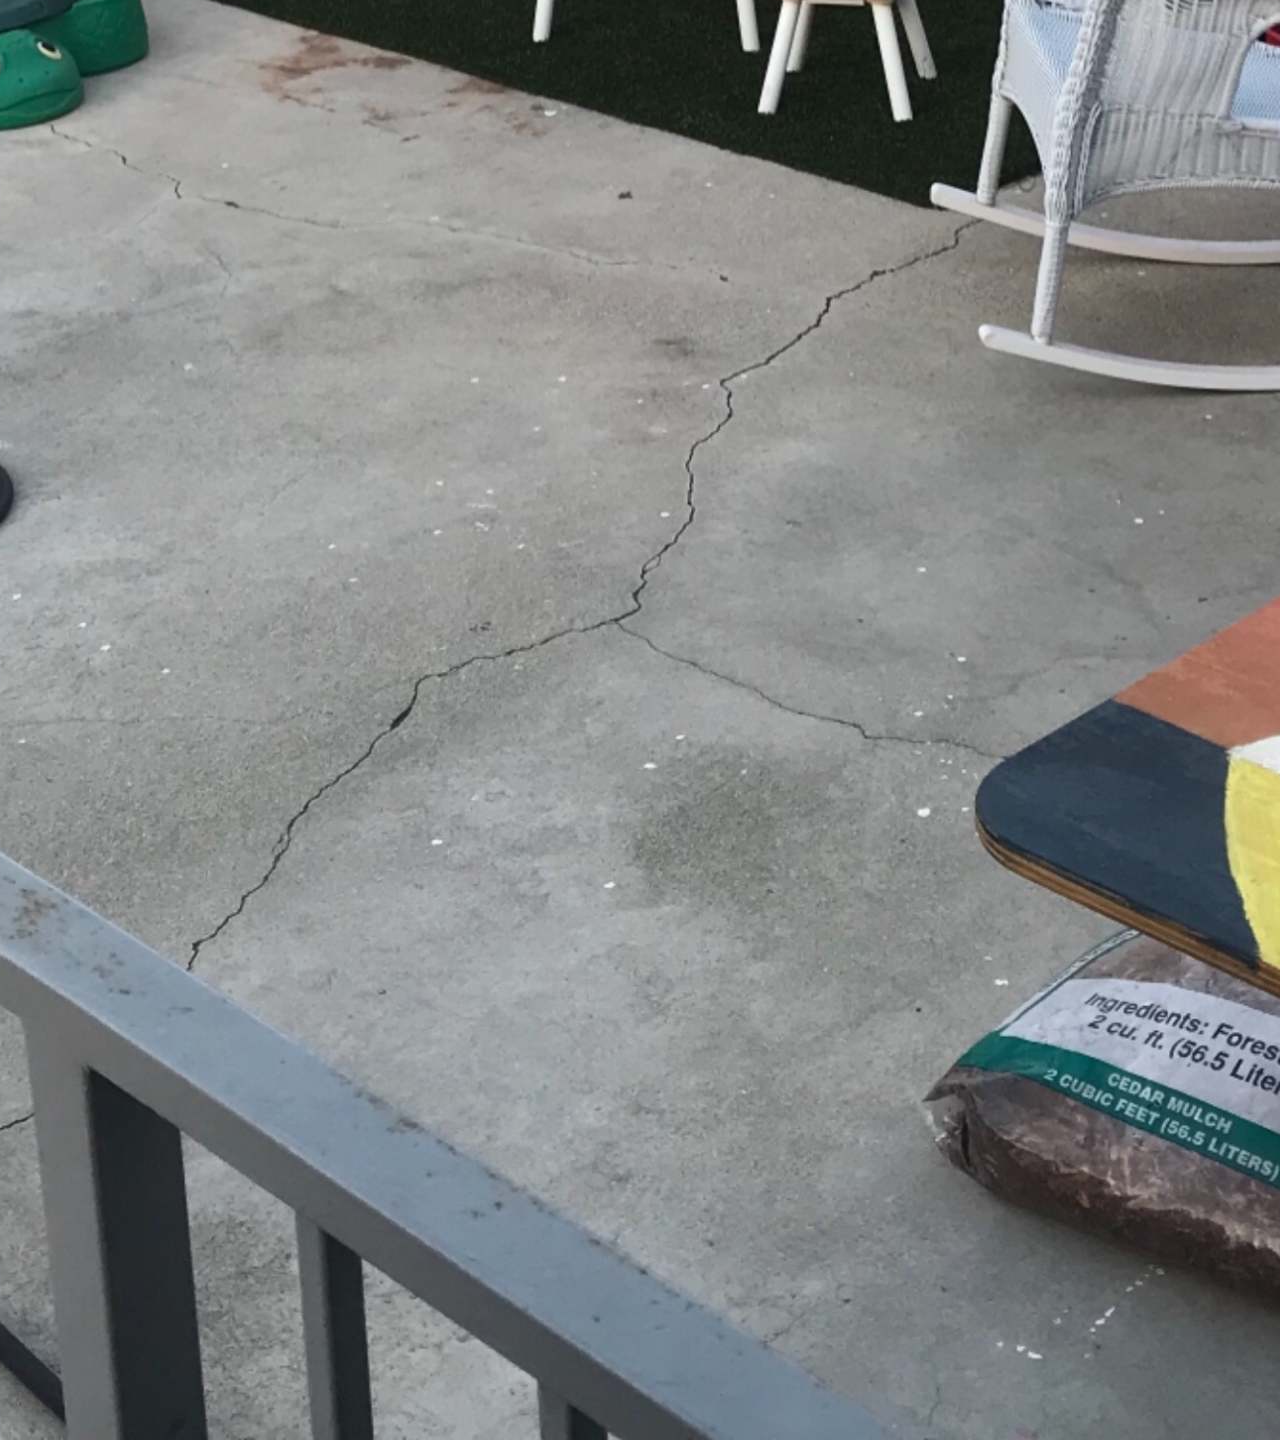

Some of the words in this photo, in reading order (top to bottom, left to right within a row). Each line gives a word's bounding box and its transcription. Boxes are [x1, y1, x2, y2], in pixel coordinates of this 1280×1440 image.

[1085, 993, 1209, 1035] Ingredients:
[1087, 1014, 1108, 1030] 2
[1106, 1019, 1137, 1041] cu.
[1144, 1030, 1164, 1049] ft.
[1169, 1038, 1231, 1071] (56.5
[1043, 1069, 1059, 1081] 2
[1059, 1074, 1114, 1106] CUBIC
[1115, 1098, 1160, 1126] FEET
[1159, 1117, 1205, 1146] (56.5
[1207, 1137, 1280, 1182] LITERS)
[1108, 1072, 1165, 1106] CEDAR
[1167, 1096, 1233, 1134] MULCH
